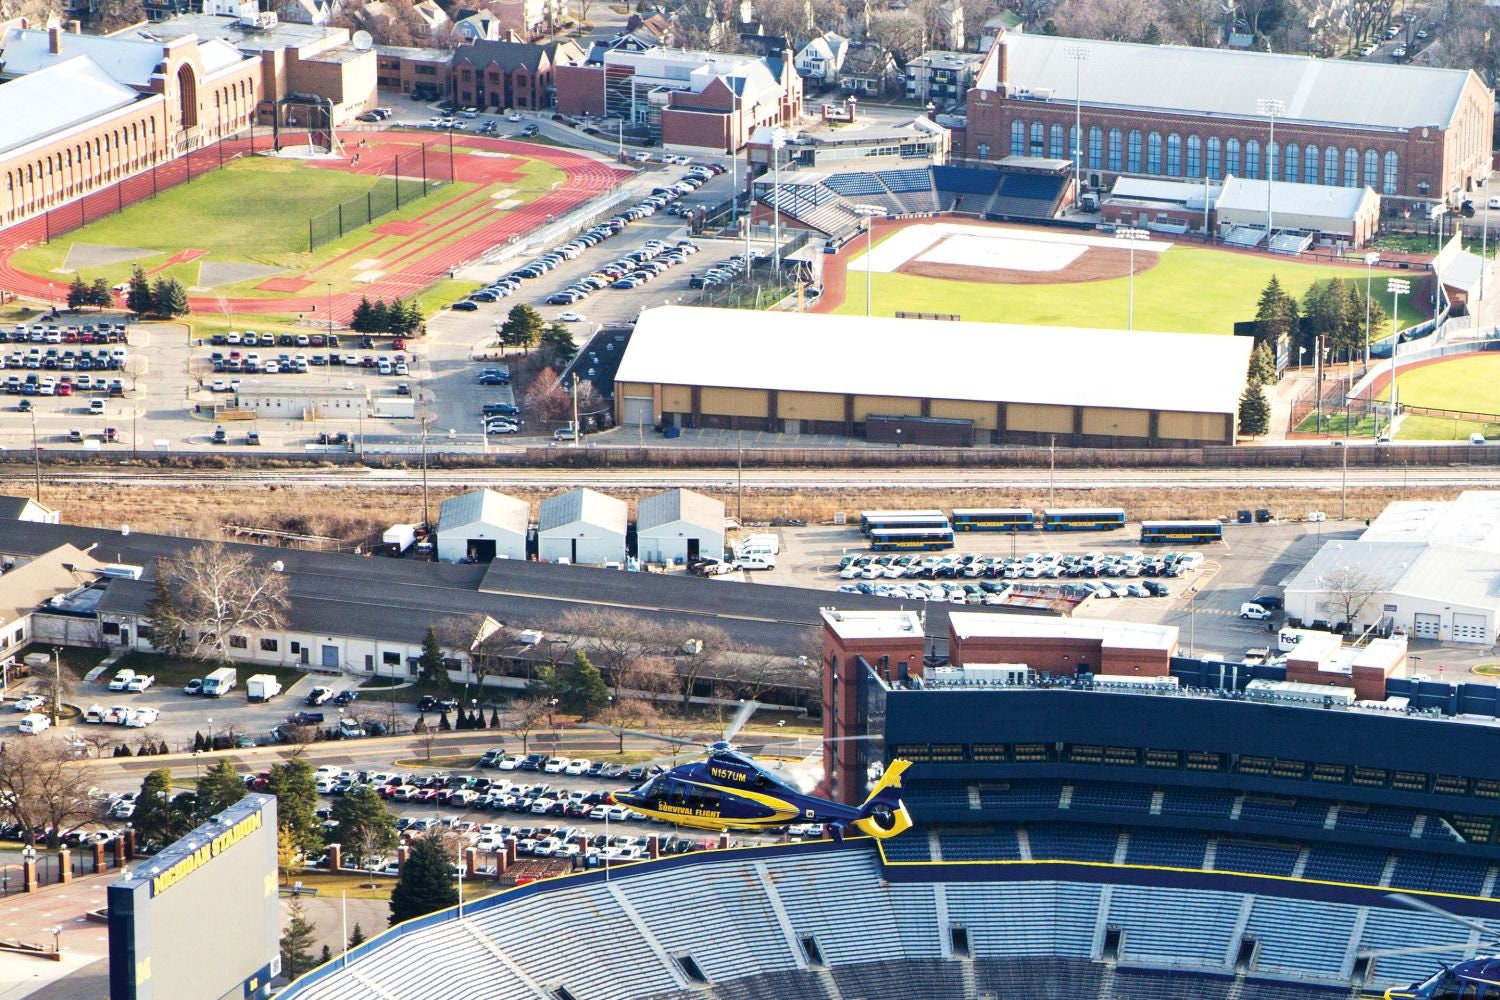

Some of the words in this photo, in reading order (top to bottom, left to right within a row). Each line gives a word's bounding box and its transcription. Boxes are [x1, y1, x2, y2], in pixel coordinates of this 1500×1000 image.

[1281, 633, 1304, 644] FedE
[711, 767, 747, 783] N157UM
[657, 803, 693, 816] SURVIVAL
[695, 809, 721, 818] FLIGHT
[154, 843, 211, 895] MICHIGAN
[212, 810, 262, 857] STADIUM
[264, 869, 278, 898] M
[136, 956, 151, 985] M
